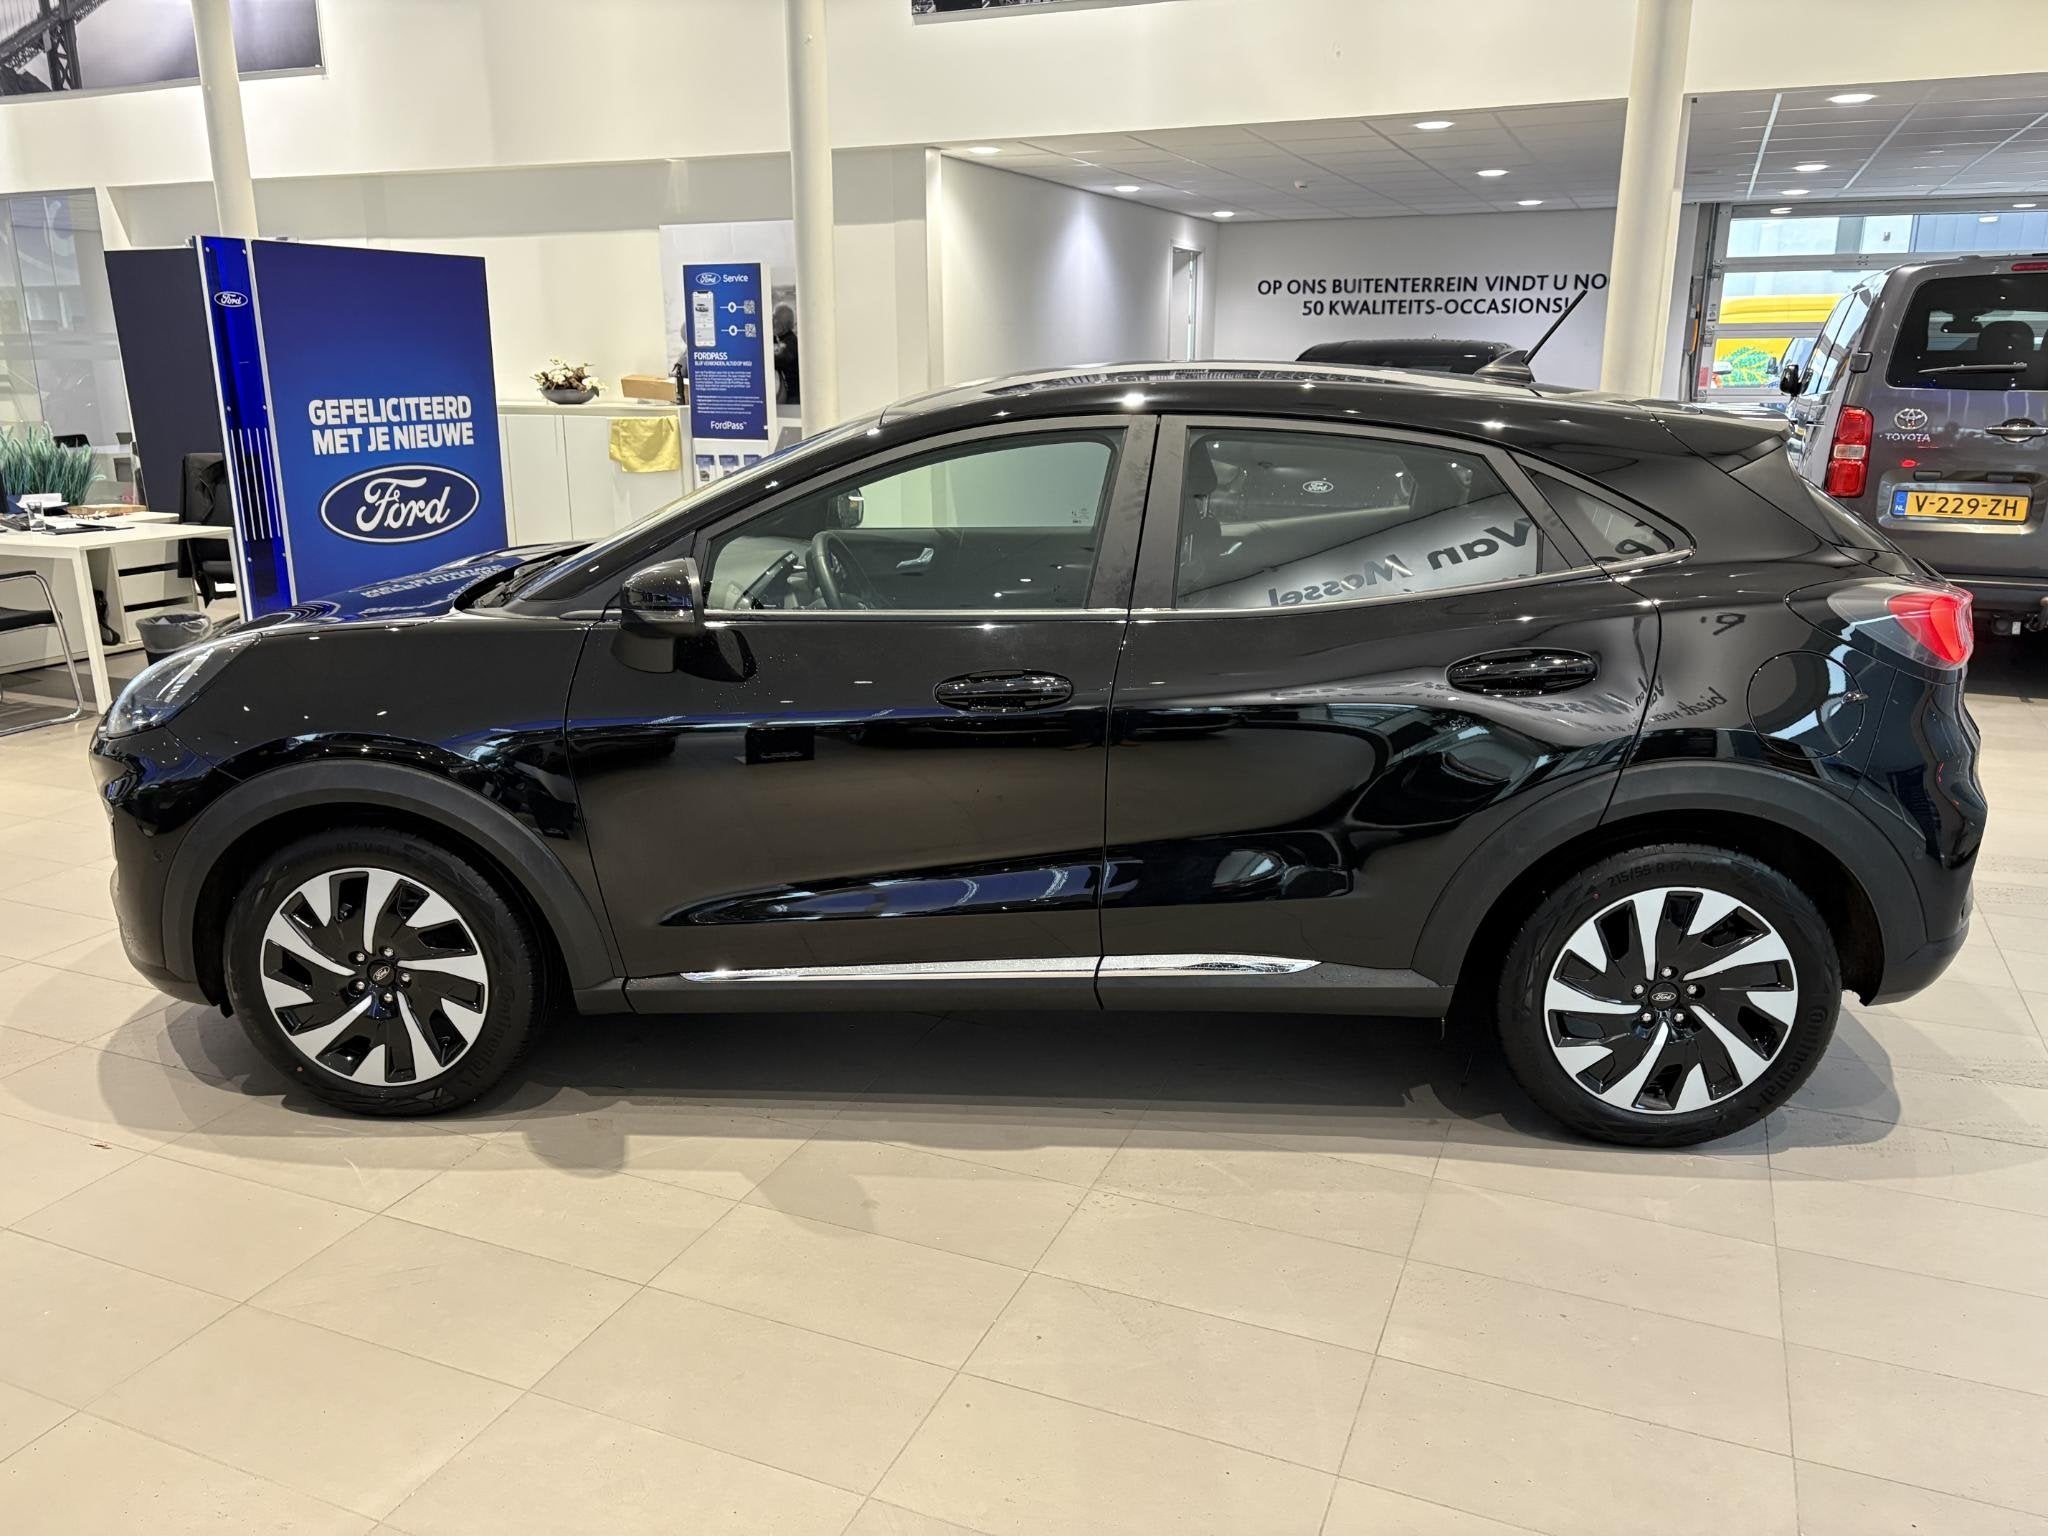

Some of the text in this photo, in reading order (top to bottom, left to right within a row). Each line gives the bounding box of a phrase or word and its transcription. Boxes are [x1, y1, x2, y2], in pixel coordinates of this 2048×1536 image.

[722, 274, 749, 283] Service
[1257, 273, 1610, 295] OP ONS BUITENTERREIN VINDT U NO
[1302, 301, 1324, 316] 50
[693, 351, 728, 361] FORDPASS
[308, 395, 472, 426] GEFELICITEERD
[312, 421, 475, 456] MET JE NIEUWE
[1884, 433, 1931, 442] TOYOTA
[355, 476, 452, 533] Ford
[1915, 495, 2018, 517] V-229-ZH
